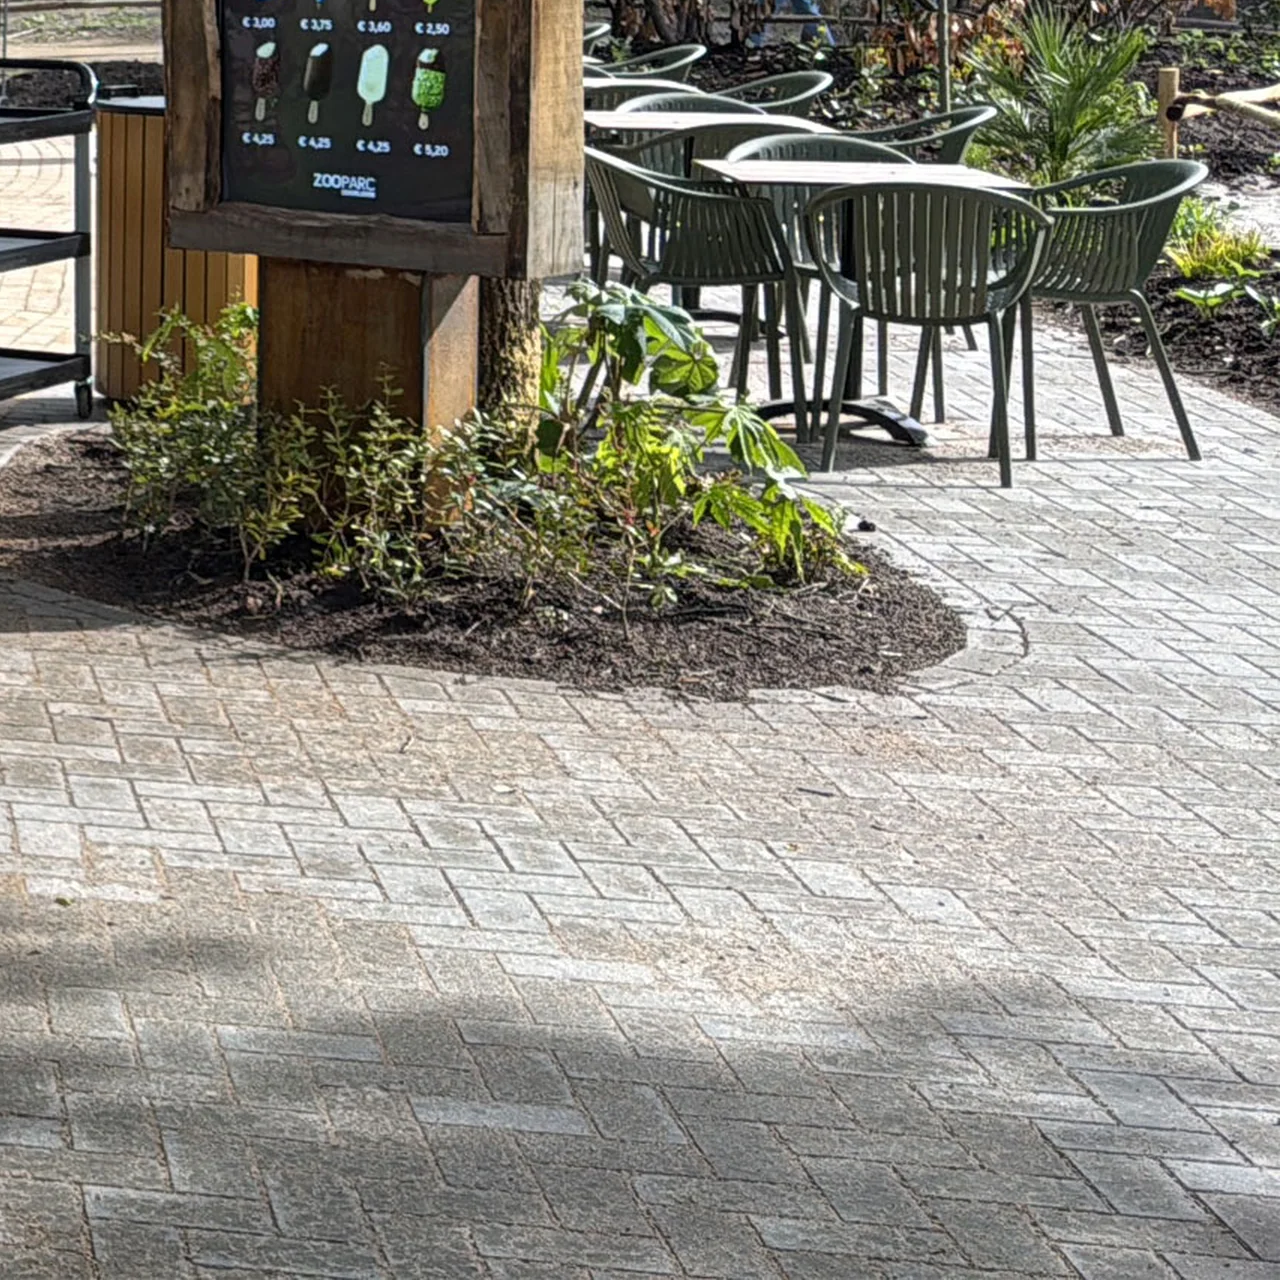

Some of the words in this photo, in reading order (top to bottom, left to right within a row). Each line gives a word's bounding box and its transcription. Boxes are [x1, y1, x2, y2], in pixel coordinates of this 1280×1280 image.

[243, 17, 251, 28] €
[253, 17, 276, 29] 3,00
[300, 19, 309, 30] €
[311, 19, 332, 31] 3,75
[357, 20, 367, 32] €
[414, 22, 424, 34] €
[426, 23, 450, 35] 2,50
[242, 132, 251, 144] €
[253, 133, 275, 145] 4,25
[298, 135, 307, 147] €
[309, 136, 332, 149] 4,25
[356, 140, 366, 151] €
[367, 140, 390, 153] 4,25
[414, 144, 423, 156] €
[425, 144, 449, 157] 5,20
[313, 172, 376, 191] ZOOPARC
